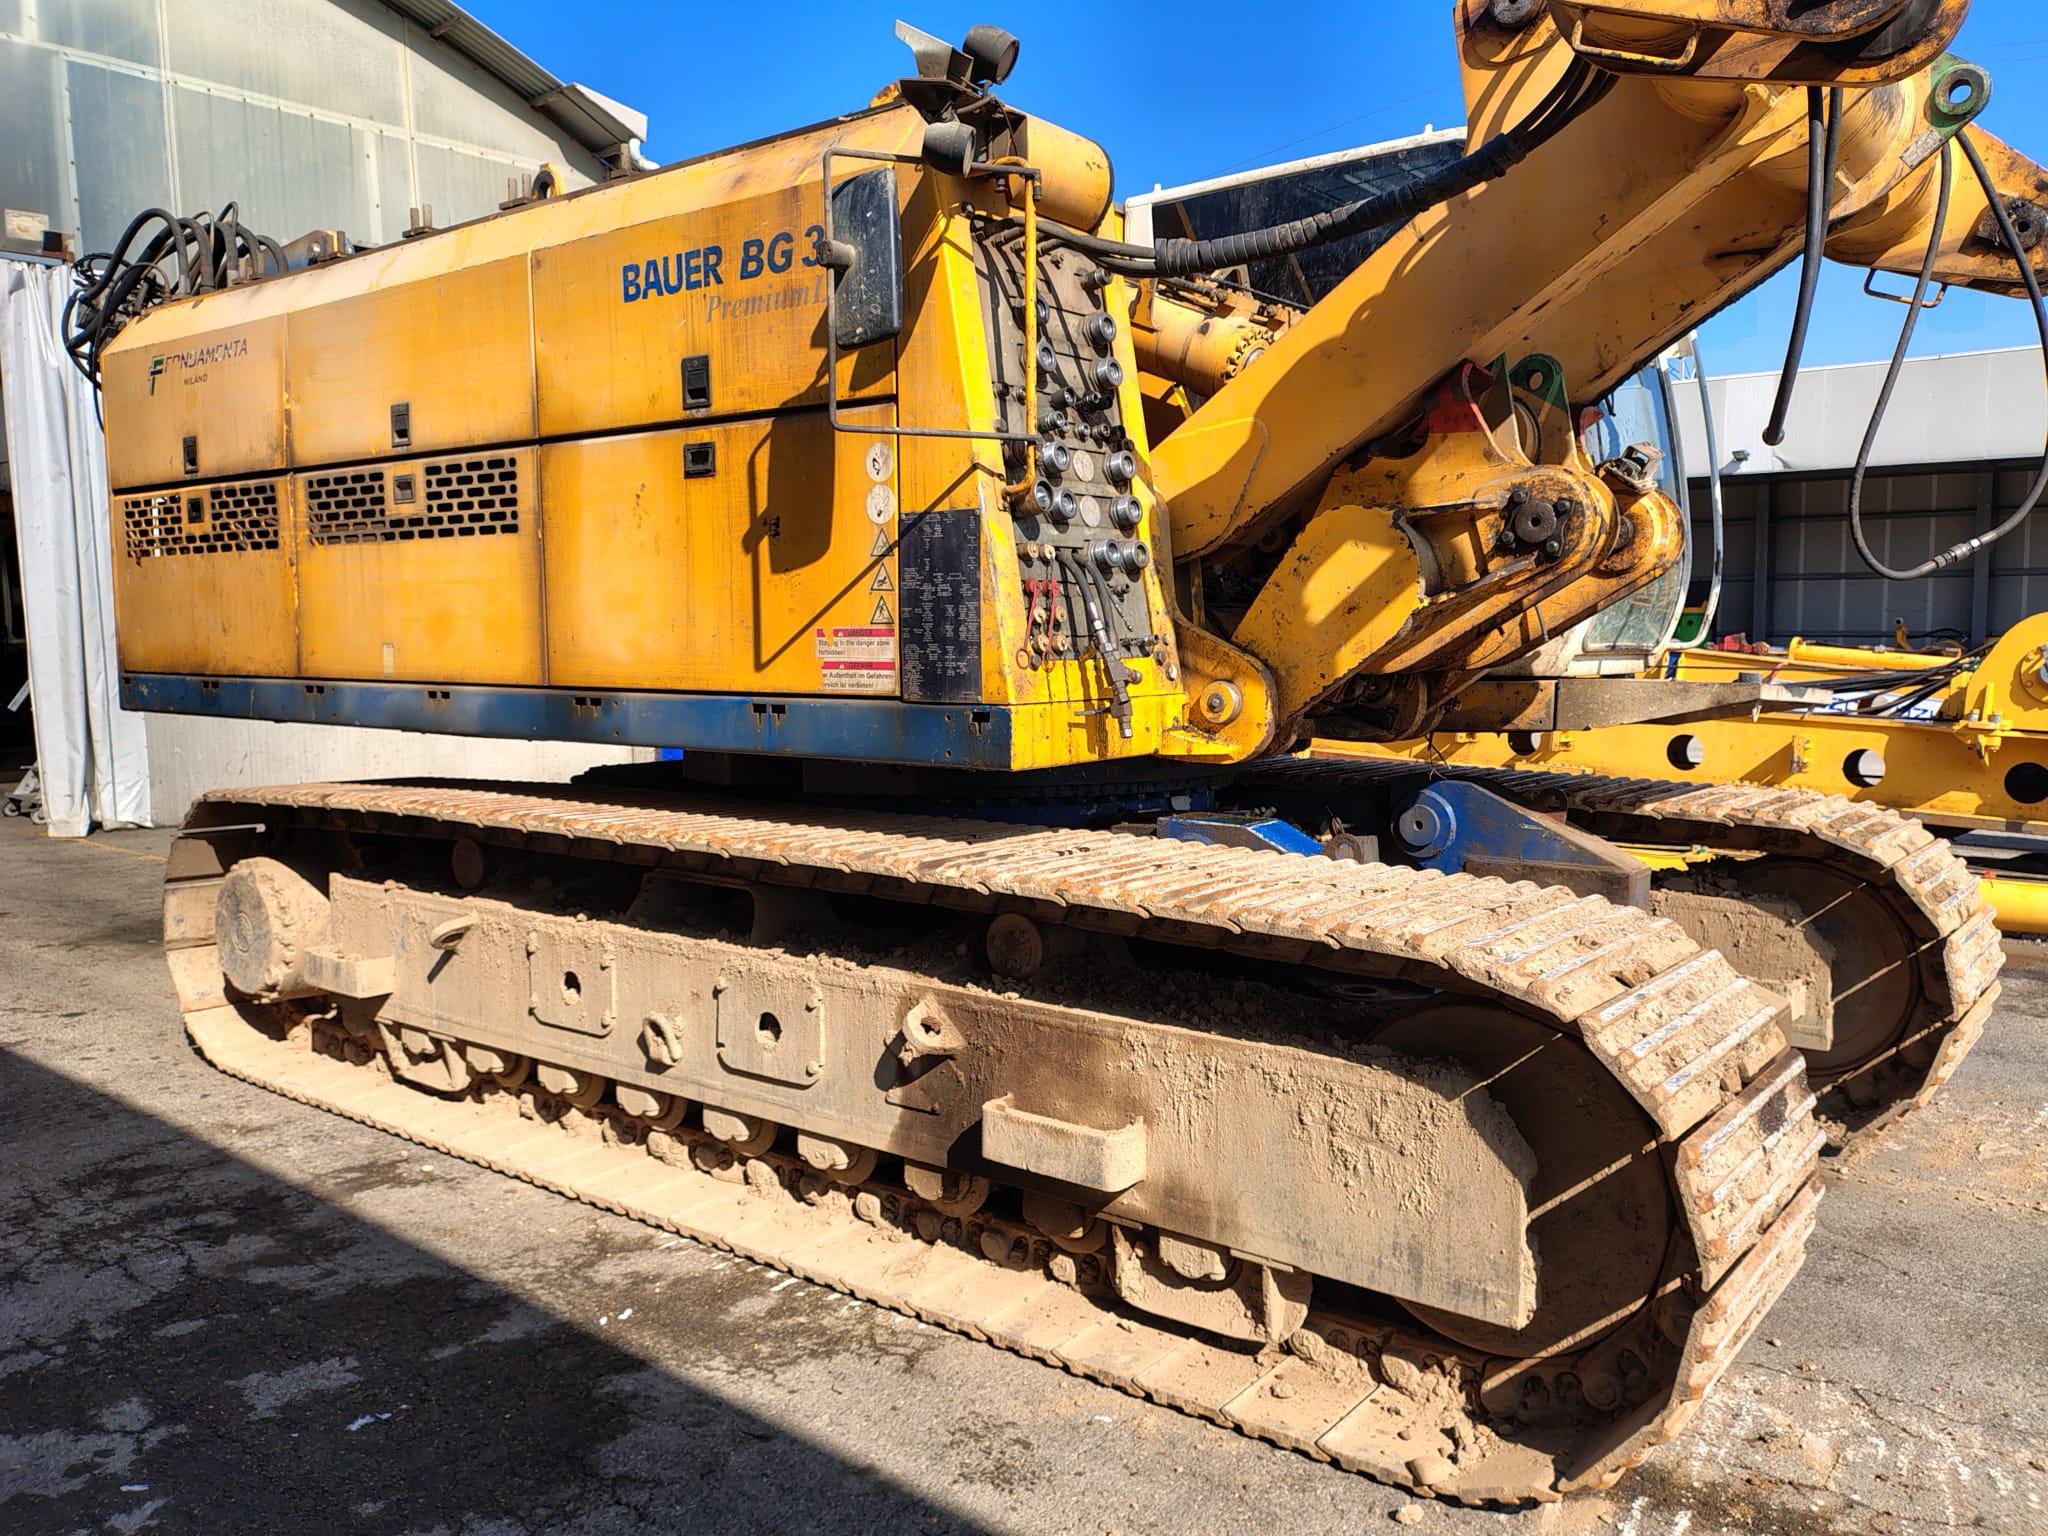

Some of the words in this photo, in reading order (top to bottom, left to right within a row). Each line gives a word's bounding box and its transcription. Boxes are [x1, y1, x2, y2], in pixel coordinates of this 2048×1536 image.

[622, 245, 723, 303] BAUER
[740, 231, 793, 280] BG
[802, 224, 825, 268] 3
[184, 374, 208, 385] MILANO
[855, 639, 875, 647] danger
